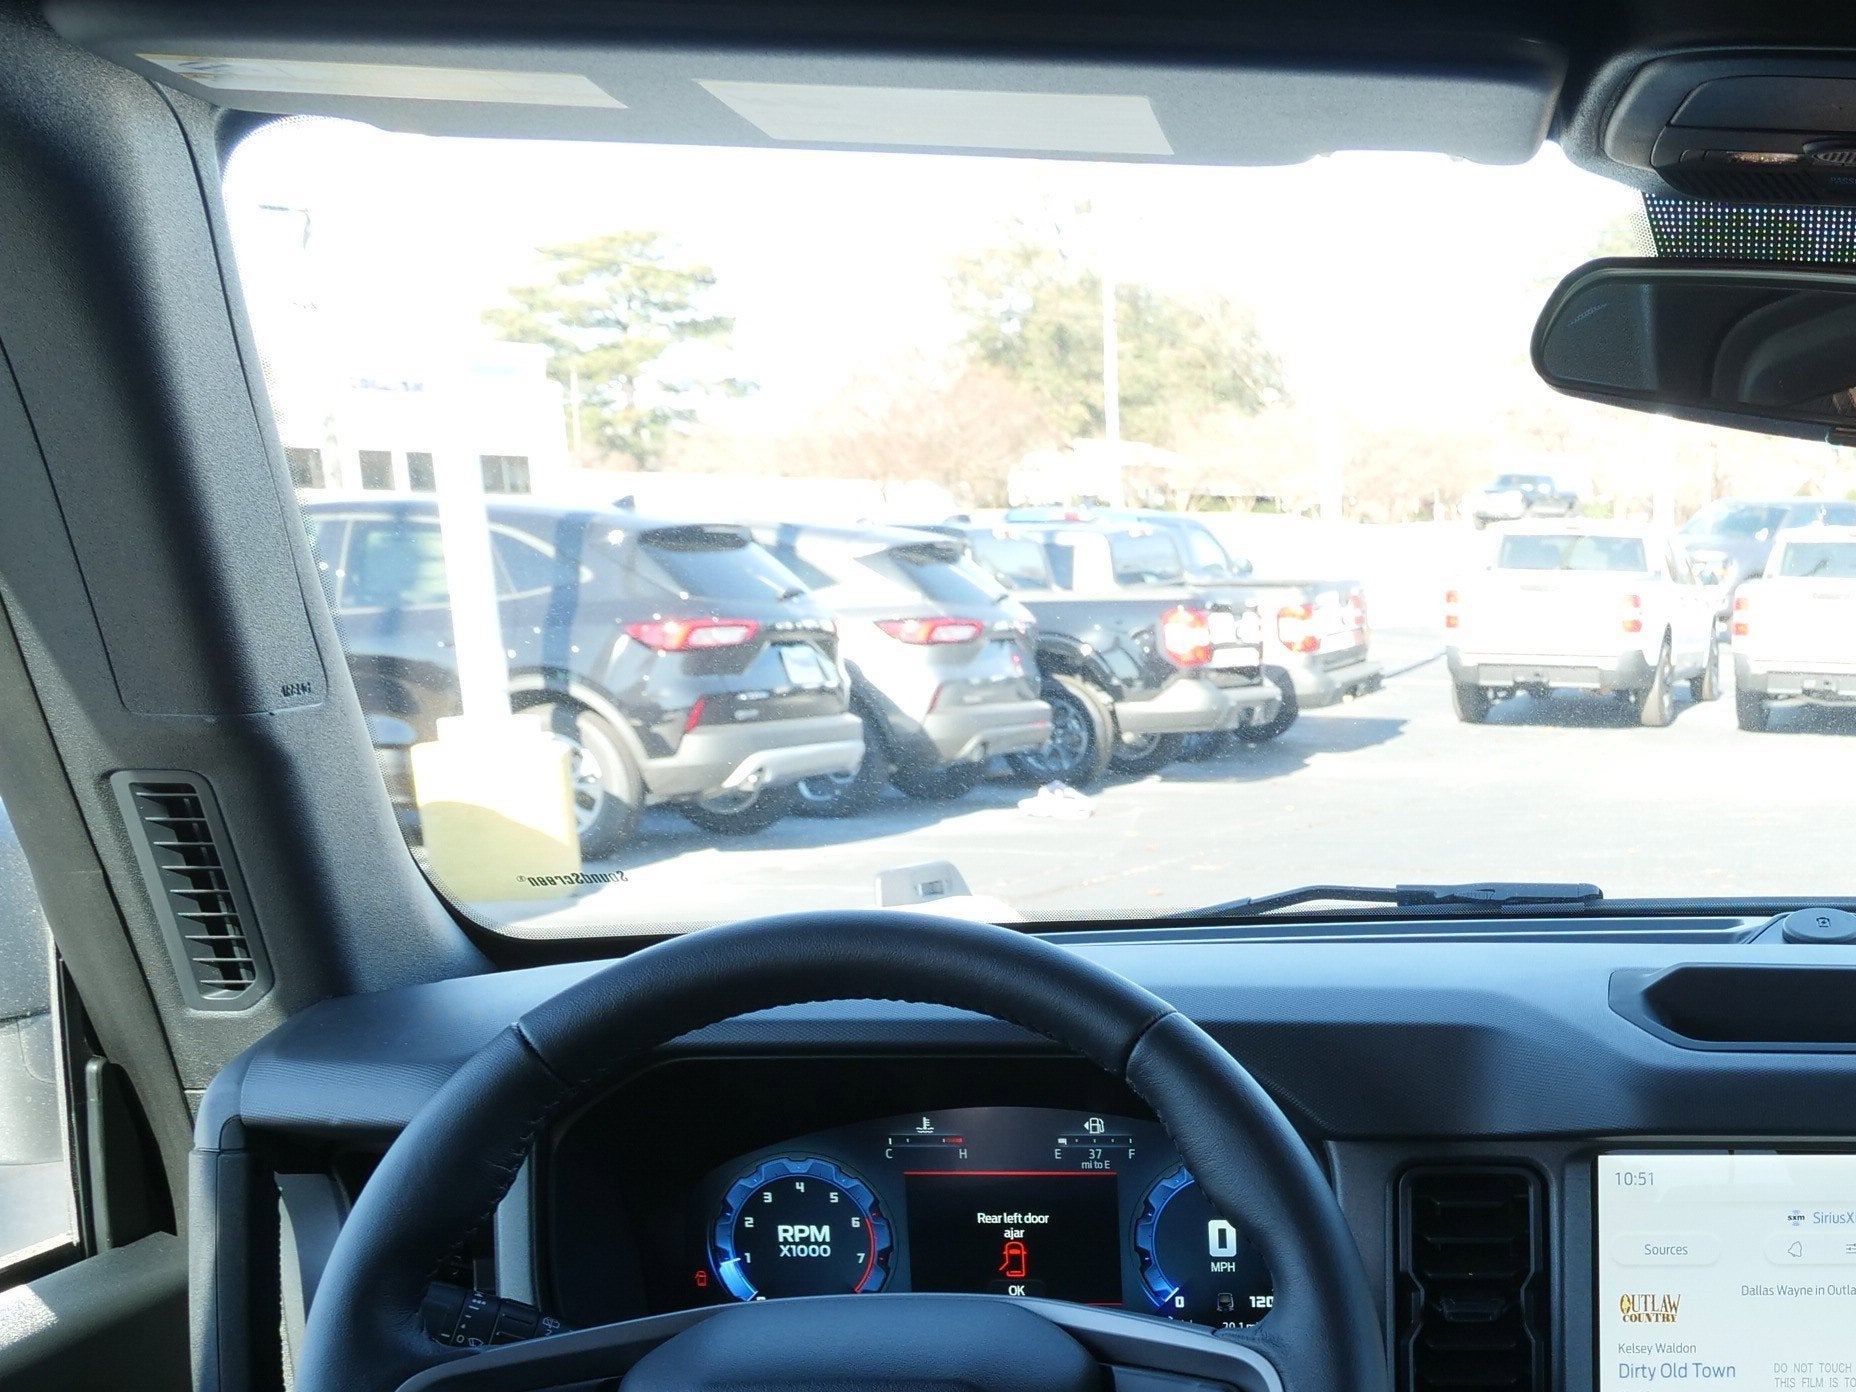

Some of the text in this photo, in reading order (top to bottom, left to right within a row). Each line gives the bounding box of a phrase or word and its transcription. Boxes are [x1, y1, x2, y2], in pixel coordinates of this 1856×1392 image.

[884, 1148, 894, 1160] C
[958, 1148, 968, 1160] H
[1054, 1148, 1062, 1160] E
[1088, 1148, 1102, 1160] 37
[1128, 1148, 1136, 1160] F
[1081, 1160, 1111, 1170] mi to E
[1615, 1171, 1655, 1187] 10:51
[795, 1181, 806, 1193] 4
[763, 1192, 773, 1203] 3
[829, 1192, 840, 1203] 5
[744, 1216, 755, 1228] 2
[851, 1216, 861, 1228] 6
[976, 1212, 1050, 1225] Rear left door
[777, 1224, 831, 1243] RPM
[1003, 1227, 1025, 1241] ajar
[1207, 1219, 1237, 1258] 0
[779, 1244, 832, 1258] X1000
[1644, 1243, 1689, 1256] Sources
[744, 1252, 752, 1263] 1
[856, 1252, 866, 1264] 7
[1210, 1261, 1236, 1273] MPH
[1008, 1285, 1026, 1297] OK
[1741, 1284, 1775, 1297] Dallas
[1777, 1285, 1813, 1298] Wayne
[1815, 1284, 1826, 1296] in
[1174, 1295, 1185, 1308] 0
[1248, 1295, 1274, 1308] 120
[1619, 1292, 1682, 1315] OUTLAW
[1622, 1313, 1677, 1323] COUNTRY
[1618, 1342, 1697, 1356] Kelsey Waldon
[1618, 1361, 1737, 1381] Dirty Old Town
[1774, 1362, 1788, 1373] DO
[1793, 1362, 1813, 1373] NOT
[1819, 1362, 1852, 1373] TOUCH
[1774, 1377, 1796, 1388] THIS
[1802, 1377, 1824, 1388] FILM
[1829, 1377, 1839, 1388] IS
[1844, 1377, 1856, 1388] TO
